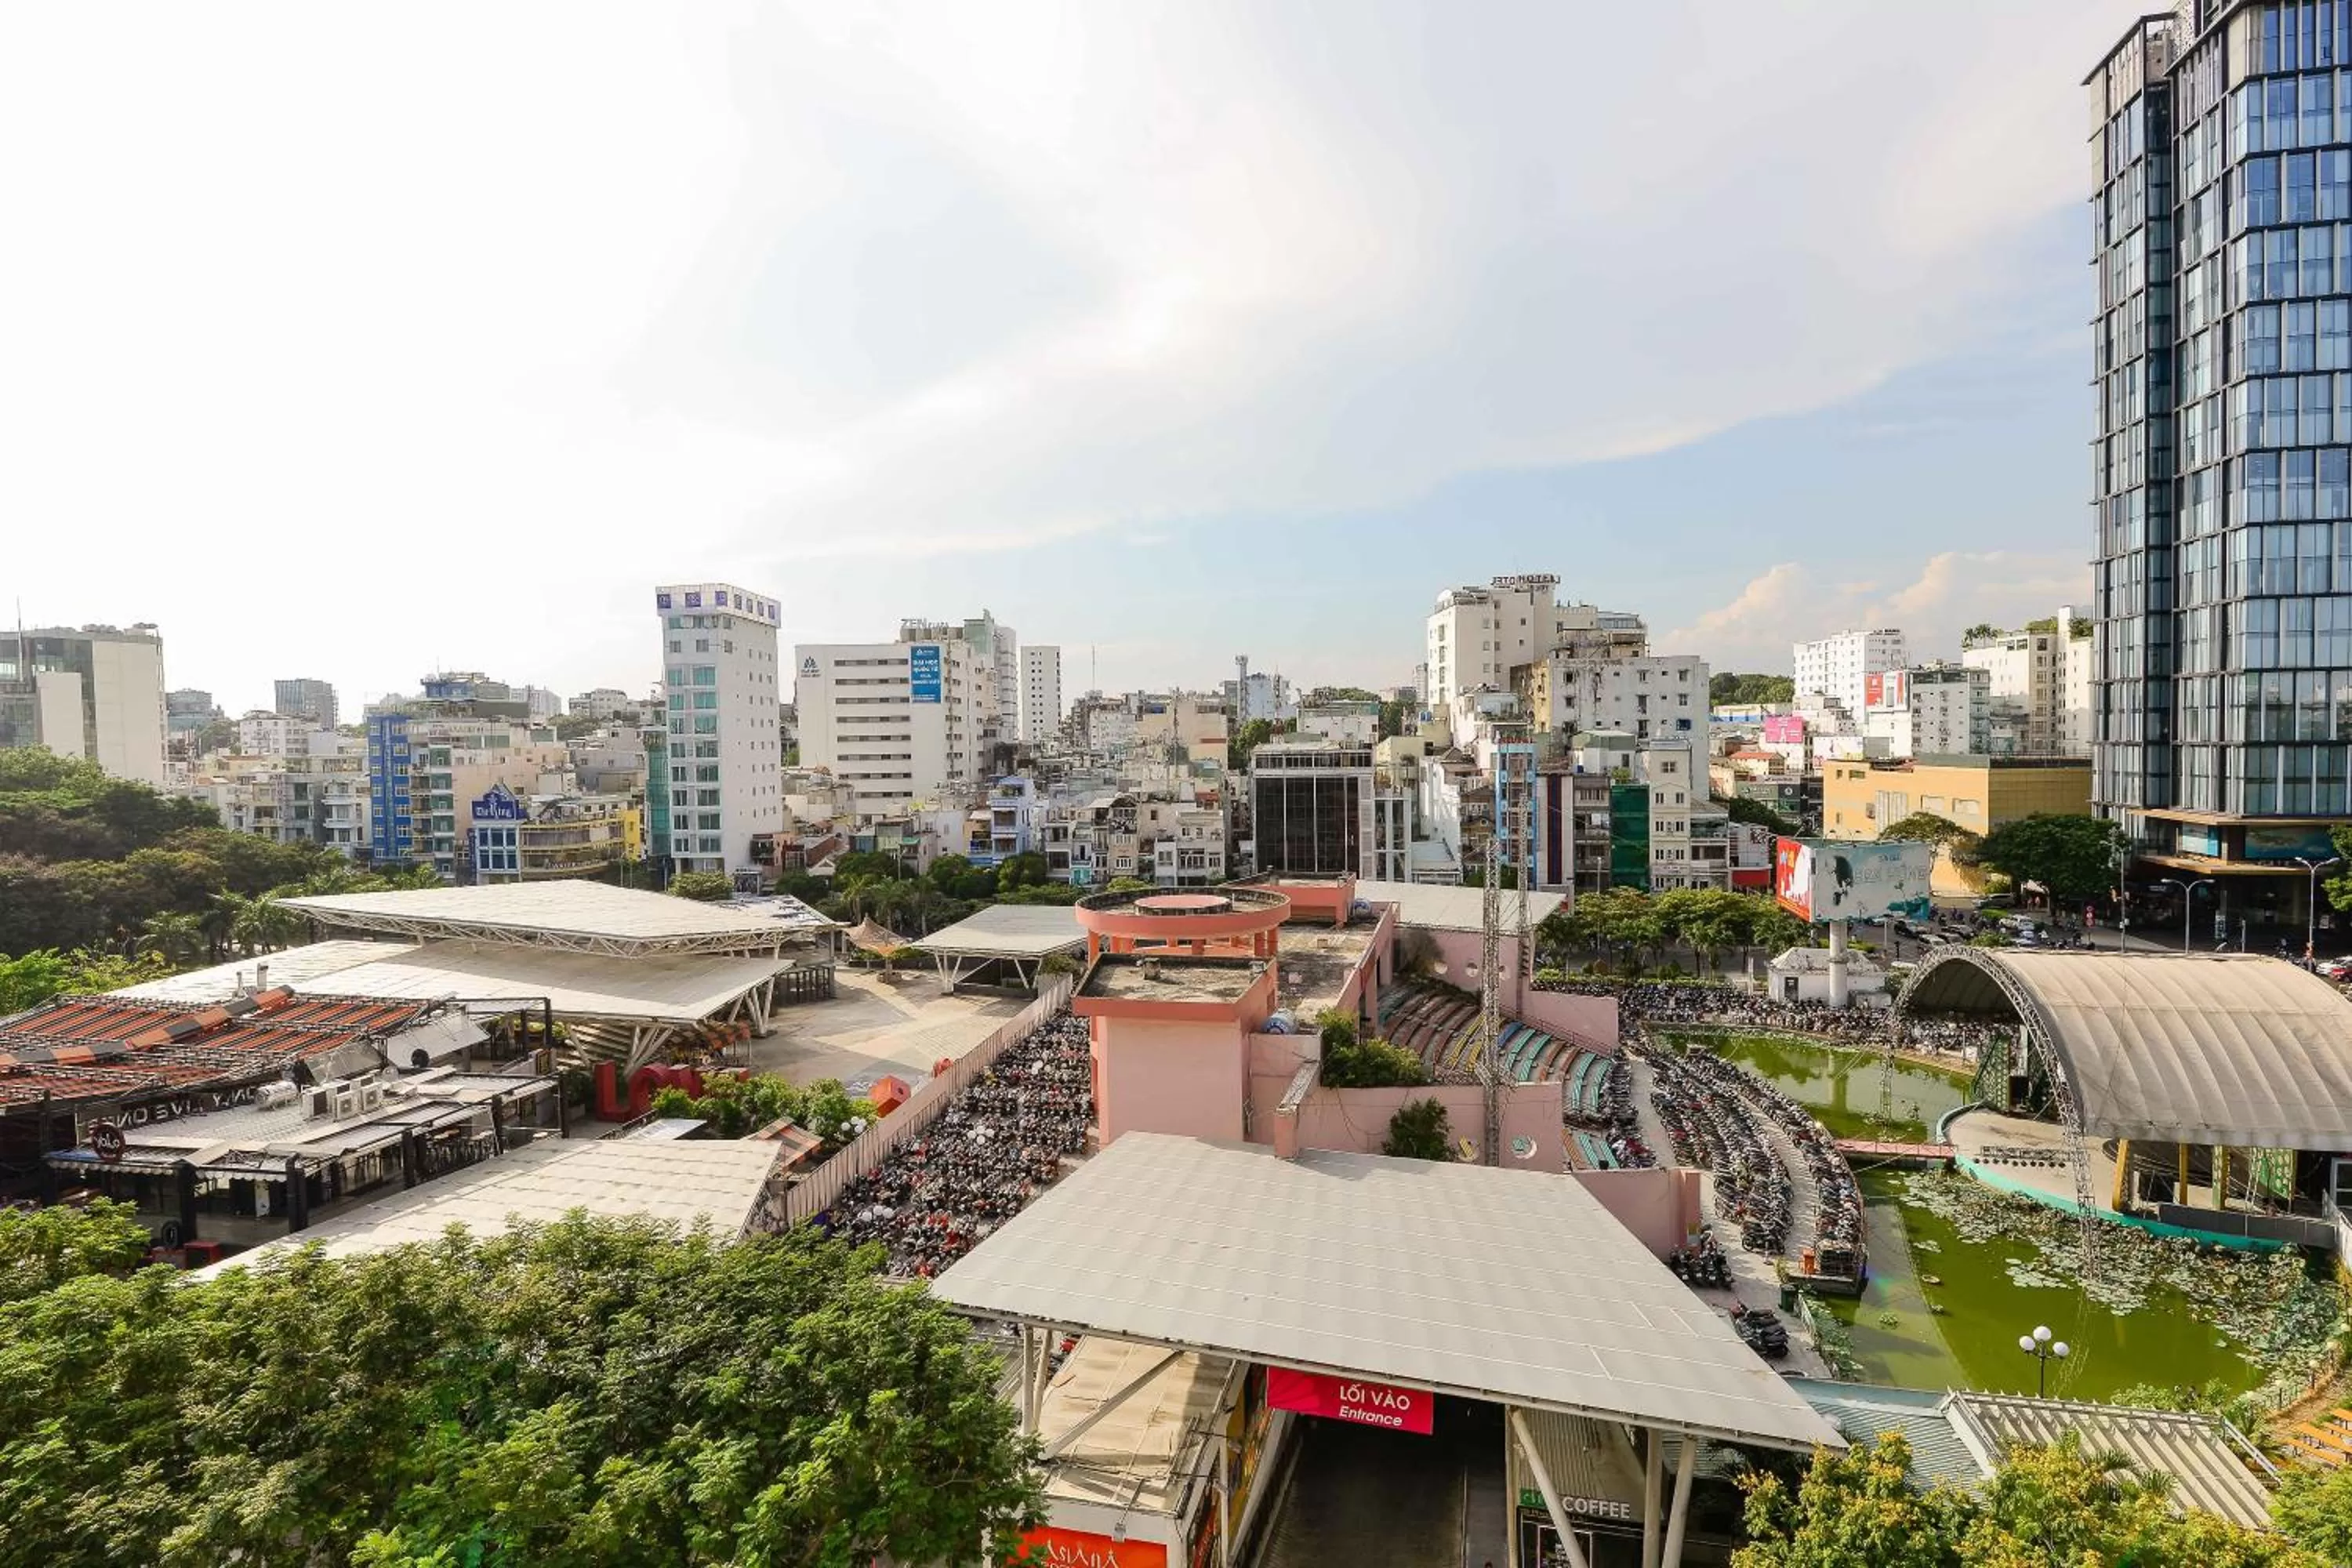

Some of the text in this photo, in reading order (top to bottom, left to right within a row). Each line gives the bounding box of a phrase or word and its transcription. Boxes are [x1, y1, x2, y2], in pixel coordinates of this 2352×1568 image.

[1340, 1384, 1410, 1410] LỐI VÀO
[1339, 1405, 1403, 1426] Entrance
[1562, 1497, 1630, 1519] COFFEE
